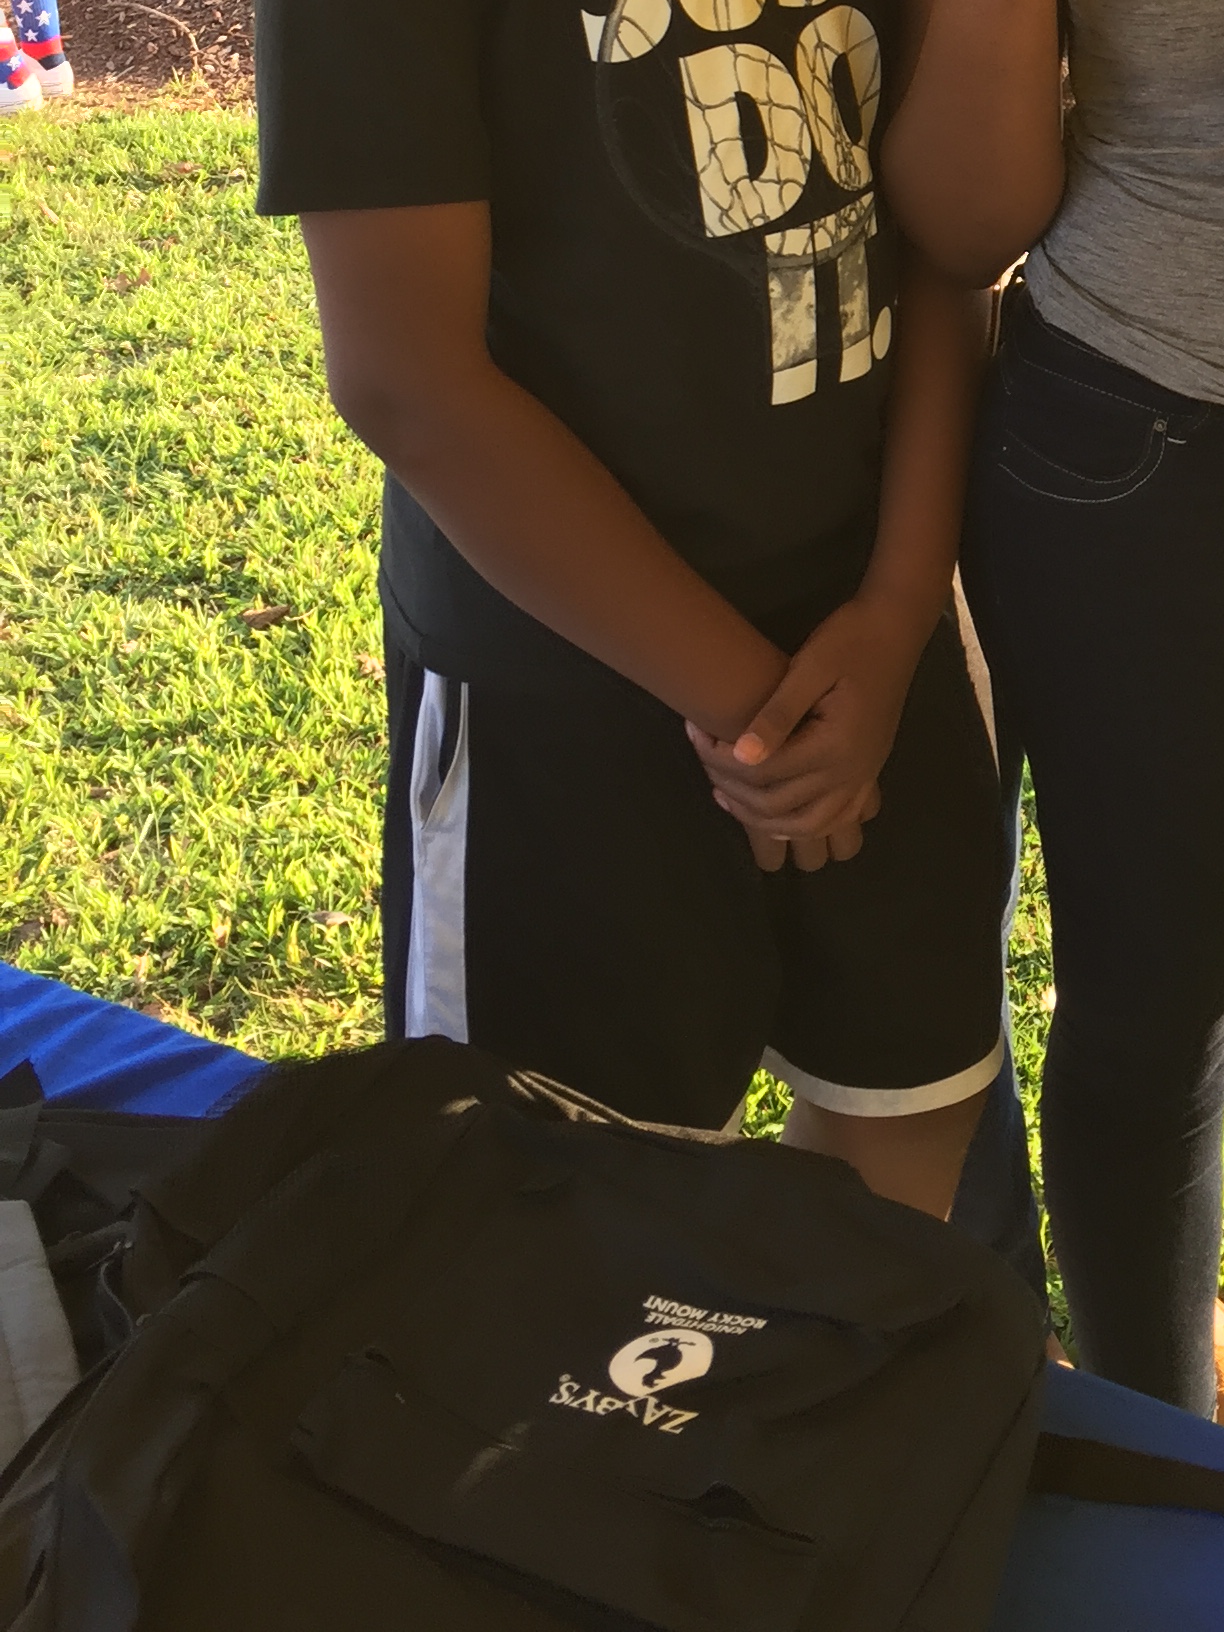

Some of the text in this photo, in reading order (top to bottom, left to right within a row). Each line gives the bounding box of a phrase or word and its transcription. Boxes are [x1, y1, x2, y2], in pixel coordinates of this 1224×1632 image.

[679, 5, 882, 239] DO
[642, 1294, 768, 1330] ROCKY MOUNT
[645, 1311, 747, 1336] KNIGHTDALE
